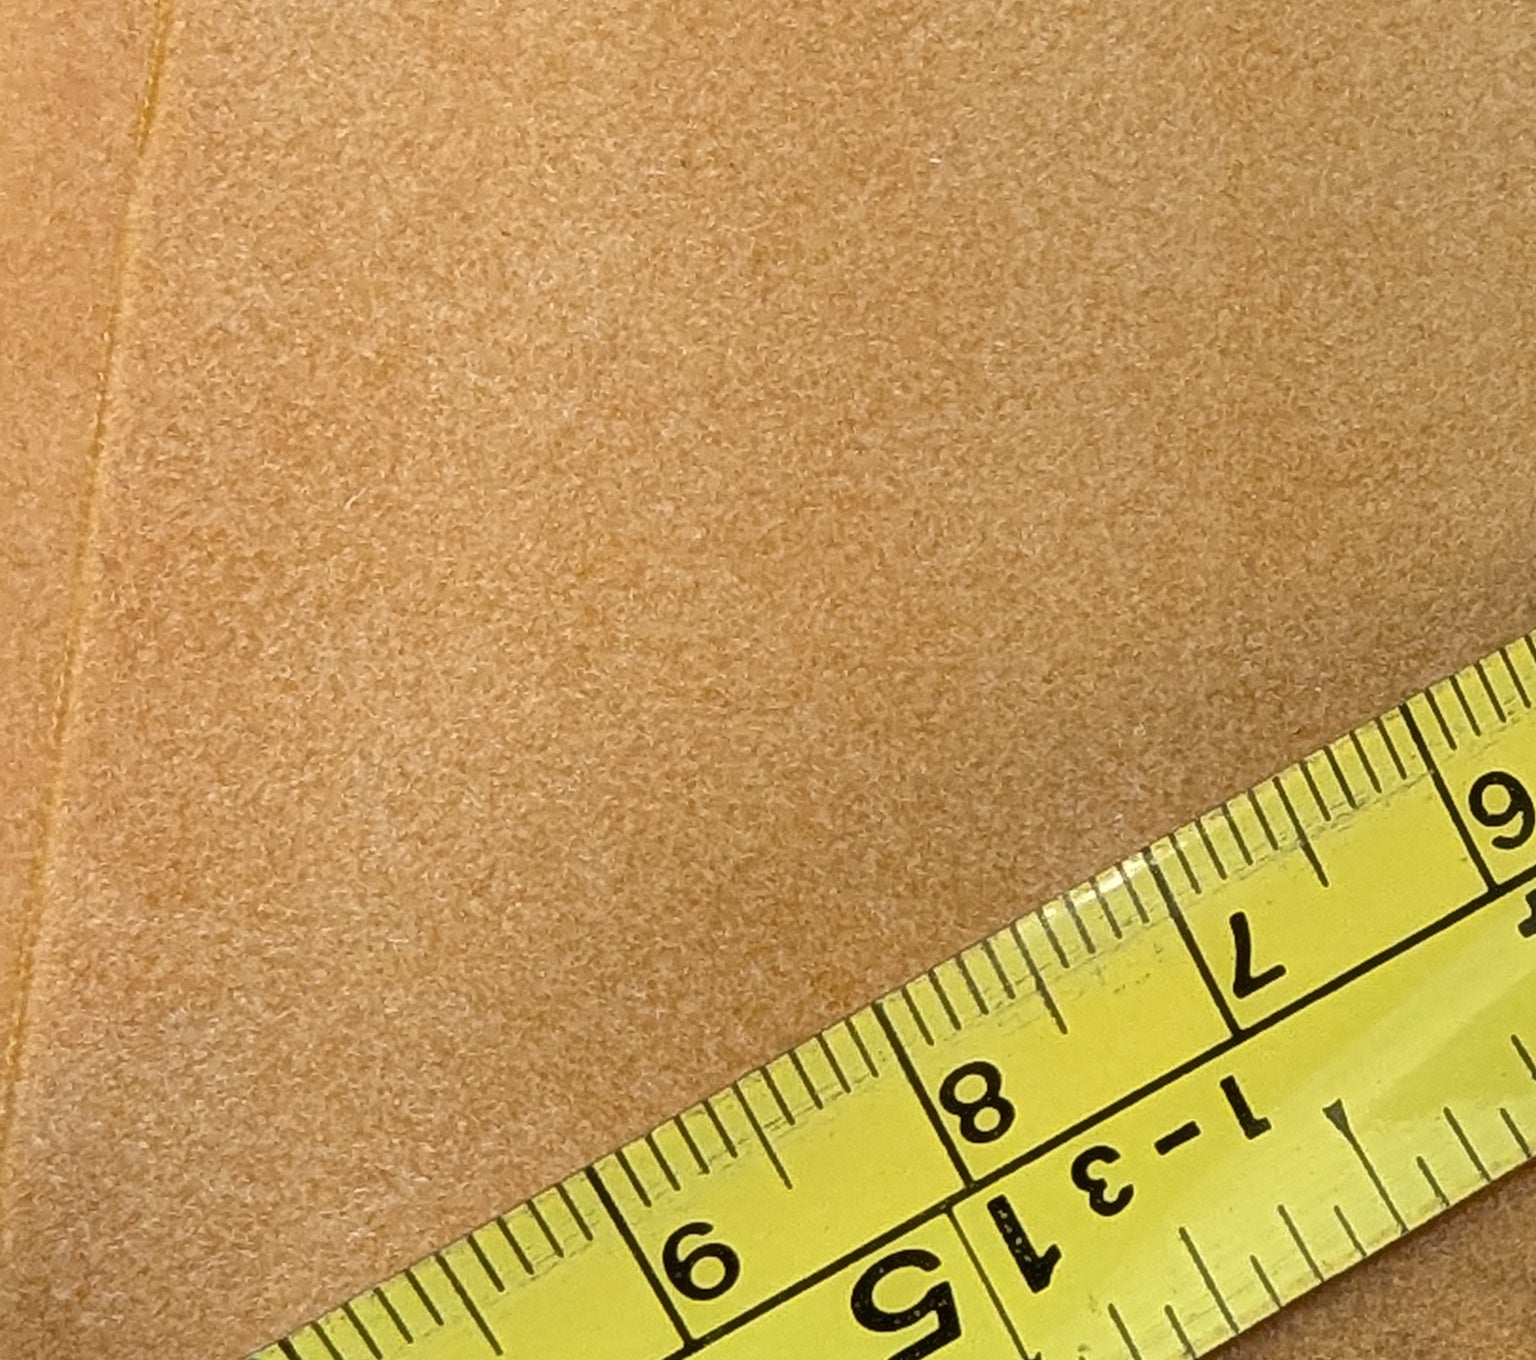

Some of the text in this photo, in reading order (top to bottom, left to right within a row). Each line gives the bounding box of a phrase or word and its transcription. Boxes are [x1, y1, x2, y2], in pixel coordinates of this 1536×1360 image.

[1469, 771, 1536, 850] 6
[1228, 911, 1287, 999] 7
[938, 1060, 1017, 1144] 8
[662, 1221, 741, 1301] 9
